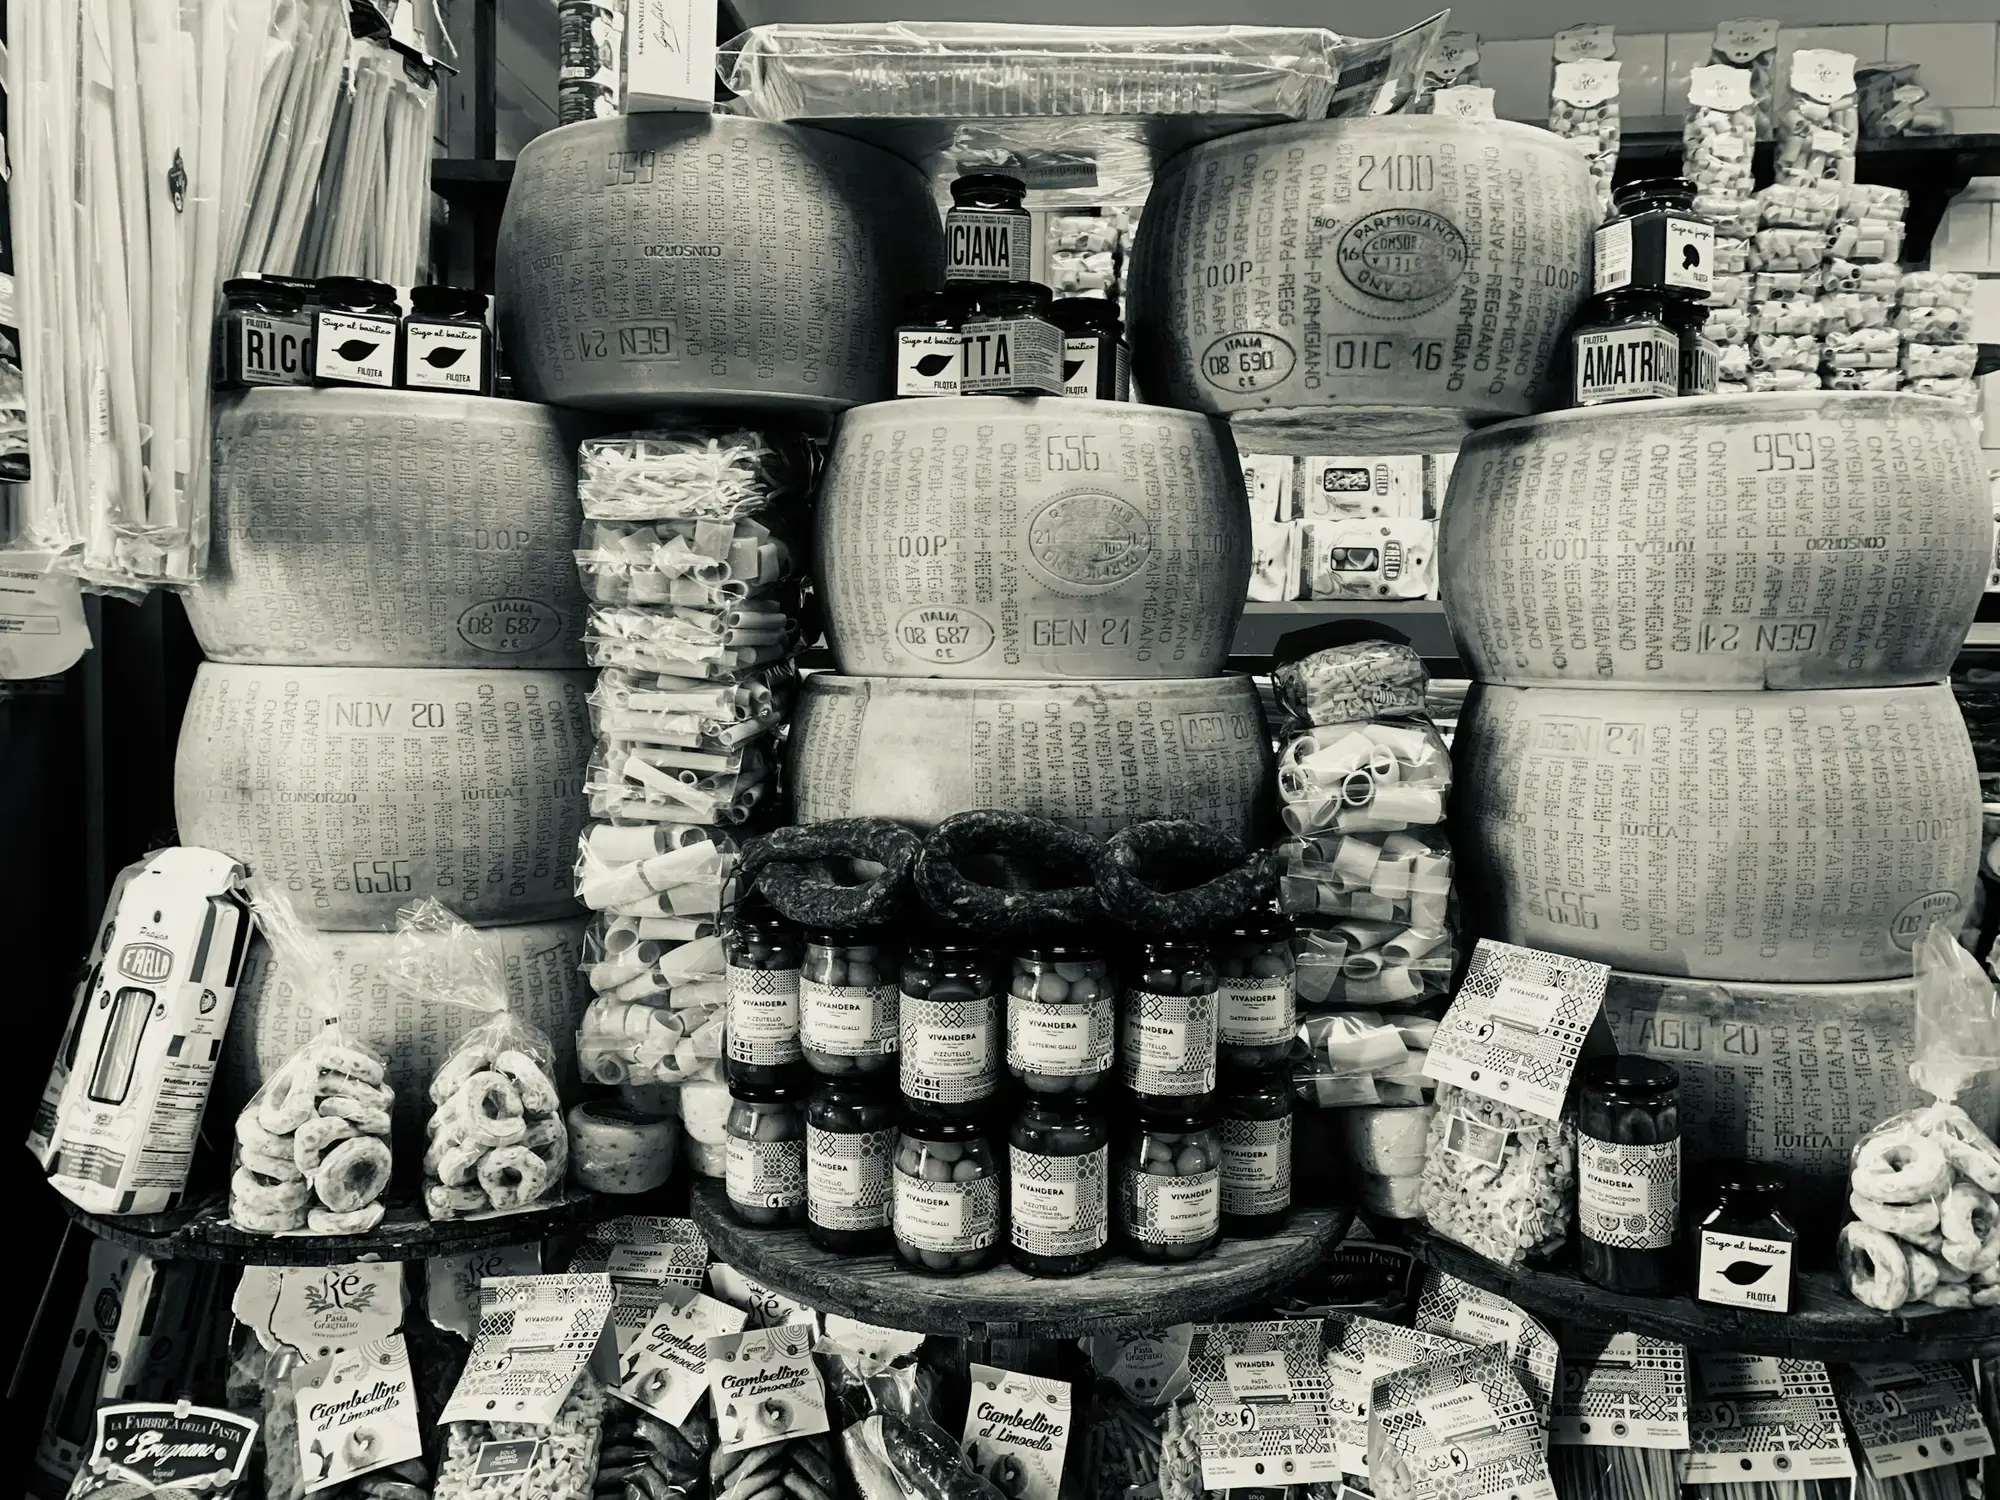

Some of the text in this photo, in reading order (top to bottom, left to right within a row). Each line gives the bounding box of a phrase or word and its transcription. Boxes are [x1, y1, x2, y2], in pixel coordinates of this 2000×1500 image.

[1358, 154, 1434, 192] 2100
[1353, 212, 1456, 243] PARMIGIANO
[321, 316, 347, 330] Sugo
[410, 327, 433, 340] Sugo
[1583, 335, 1609, 346] FILOTEA
[1224, 336, 1262, 352] ITALIA
[1209, 351, 1274, 373] 08 690
[1411, 342, 1443, 371] 16
[1046, 435, 1100, 472] 656
[492, 601, 533, 616] ITALIA
[920, 611, 959, 625] ITALIA
[505, 617, 541, 635] 687
[1033, 618, 1131, 647] GEN 21
[904, 624, 971, 645] 08 687
[335, 702, 444, 728] NOV 20
[1605, 722, 1643, 755] 21
[461, 786, 515, 800] TUTELA
[1619, 822, 1678, 841] TUTELA
[353, 860, 412, 895] 656
[1229, 994, 1277, 1002] VIVANDERA
[1509, 987, 1550, 1002] VIVANDERA
[742, 999, 788, 1007] VIVANDERA
[815, 1000, 861, 1011] VIVANDERA
[1028, 1019, 1078, 1029] VIVANDERA
[1129, 1020, 1175, 1035] VIVANDERA
[928, 1033, 977, 1042] VIVANDERA
[1721, 1023, 1760, 1056] 20
[933, 1050, 972, 1058] PIZZUTELLO
[1774, 1134, 1834, 1149] TUTELA
[1221, 1147, 1268, 1158] VIVANDERA
[1587, 1173, 1634, 1189] VIVANDERA
[1018, 1182, 1065, 1196] VIVANDERA
[1170, 1186, 1213, 1201] VIVANDERA
[905, 1192, 950, 1207] VIVANDERA
[1605, 1193, 1641, 1203] POMODORO
[622, 1249, 663, 1257] VIVANDERA
[1705, 1236, 1732, 1251] Sugo
[1748, 1242, 1788, 1256] basilico
[1746, 1290, 1777, 1303] FILOTEA
[313, 1319, 360, 1331] Gragnano
[325, 1312, 349, 1323] Pasta
[524, 1315, 564, 1323] VIVANDERA
[1467, 1309, 1510, 1328] VIVANDERA
[1234, 1360, 1276, 1369] VIVANDERA
[720, 1364, 810, 1390] Ciambelline
[308, 1379, 407, 1423] Ciambelline
[1428, 1394, 1474, 1411] VIVANDERA
[976, 1401, 1064, 1438] Ciambelline
[997, 1428, 1053, 1453] Limocello
